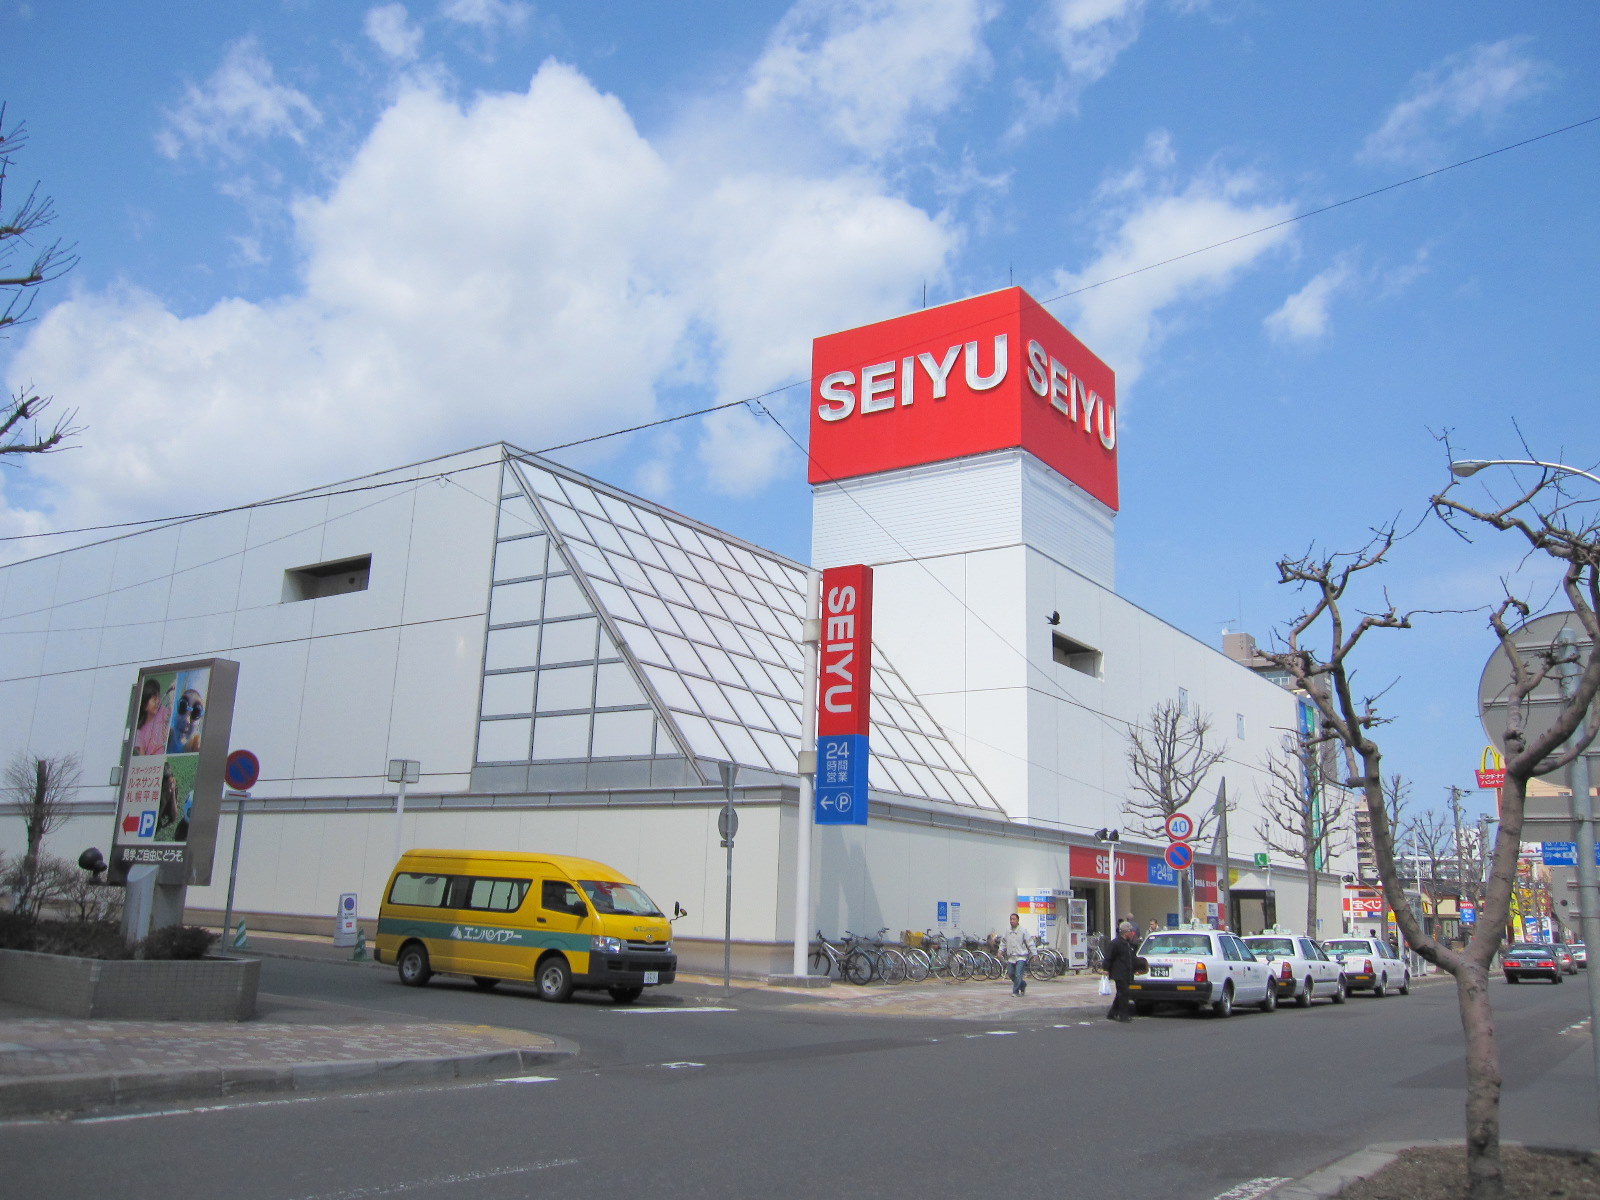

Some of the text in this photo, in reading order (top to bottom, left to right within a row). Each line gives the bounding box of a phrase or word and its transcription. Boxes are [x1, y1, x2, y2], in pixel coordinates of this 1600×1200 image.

[817, 333, 1008, 423] SEIYU
[1026, 338, 1116, 451] SEIYU
[825, 585, 856, 713] SEIYU
[826, 742, 849, 760] 24
[131, 765, 162, 775] スポーツクラブ
[826, 760, 848, 772] 時間
[128, 777, 160, 789] ルネサンス
[826, 771, 848, 783] 営業
[127, 790, 159, 803] 札幌平岸
[141, 813, 155, 835] P
[1172, 821, 1187, 833] 40
[1096, 854, 1125, 877] SEYU
[1353, 900, 1382, 910] 宝くじ
[463, 926, 523, 942] エンパイアー
